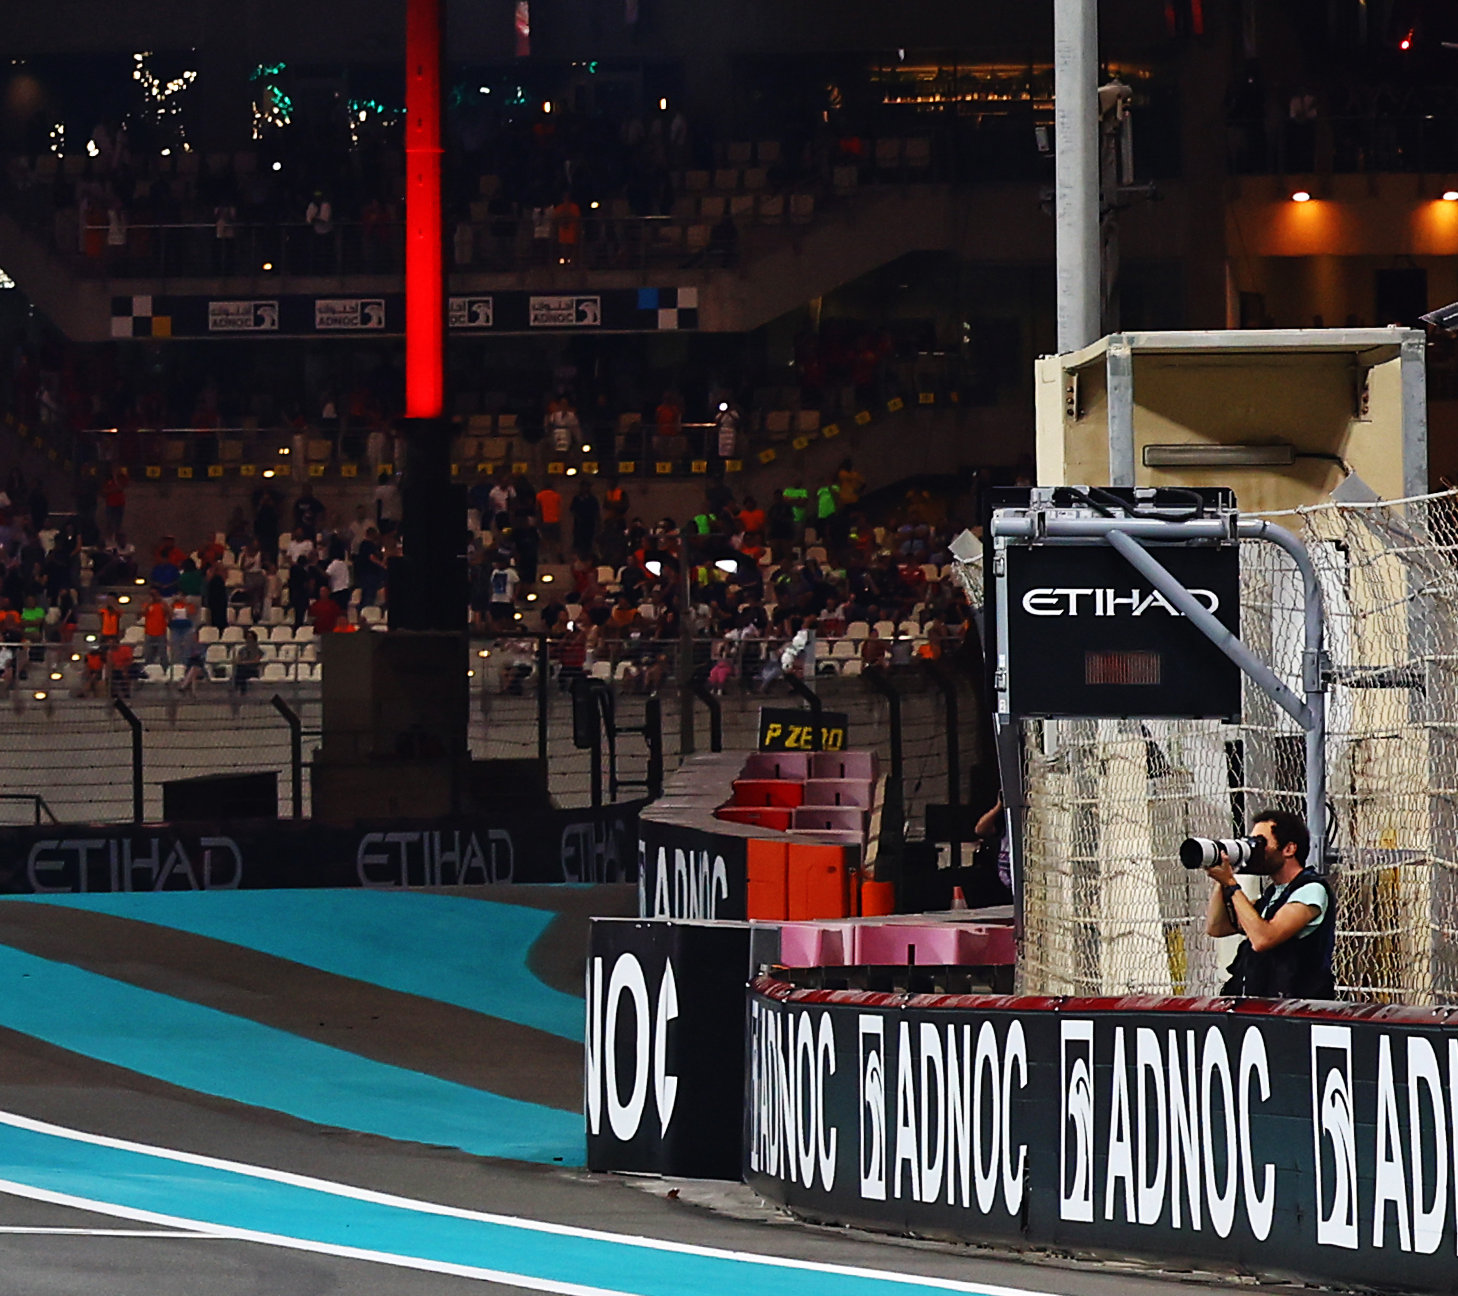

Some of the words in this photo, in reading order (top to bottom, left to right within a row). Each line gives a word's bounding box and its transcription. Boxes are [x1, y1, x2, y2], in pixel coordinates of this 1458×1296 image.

[212, 317, 252, 327] ADNOC
[319, 316, 359, 326] ADNOC
[532, 312, 573, 322] ADNOC
[765, 723, 782, 746] P
[27, 837, 244, 892] ETIHAD
[357, 829, 514, 886] ETIHAD
[654, 846, 729, 919] ADNOC
[760, 1008, 837, 1192] ADNOC
[894, 1019, 1027, 1215] ADNOC
[1105, 1025, 1275, 1241] ADNOC
